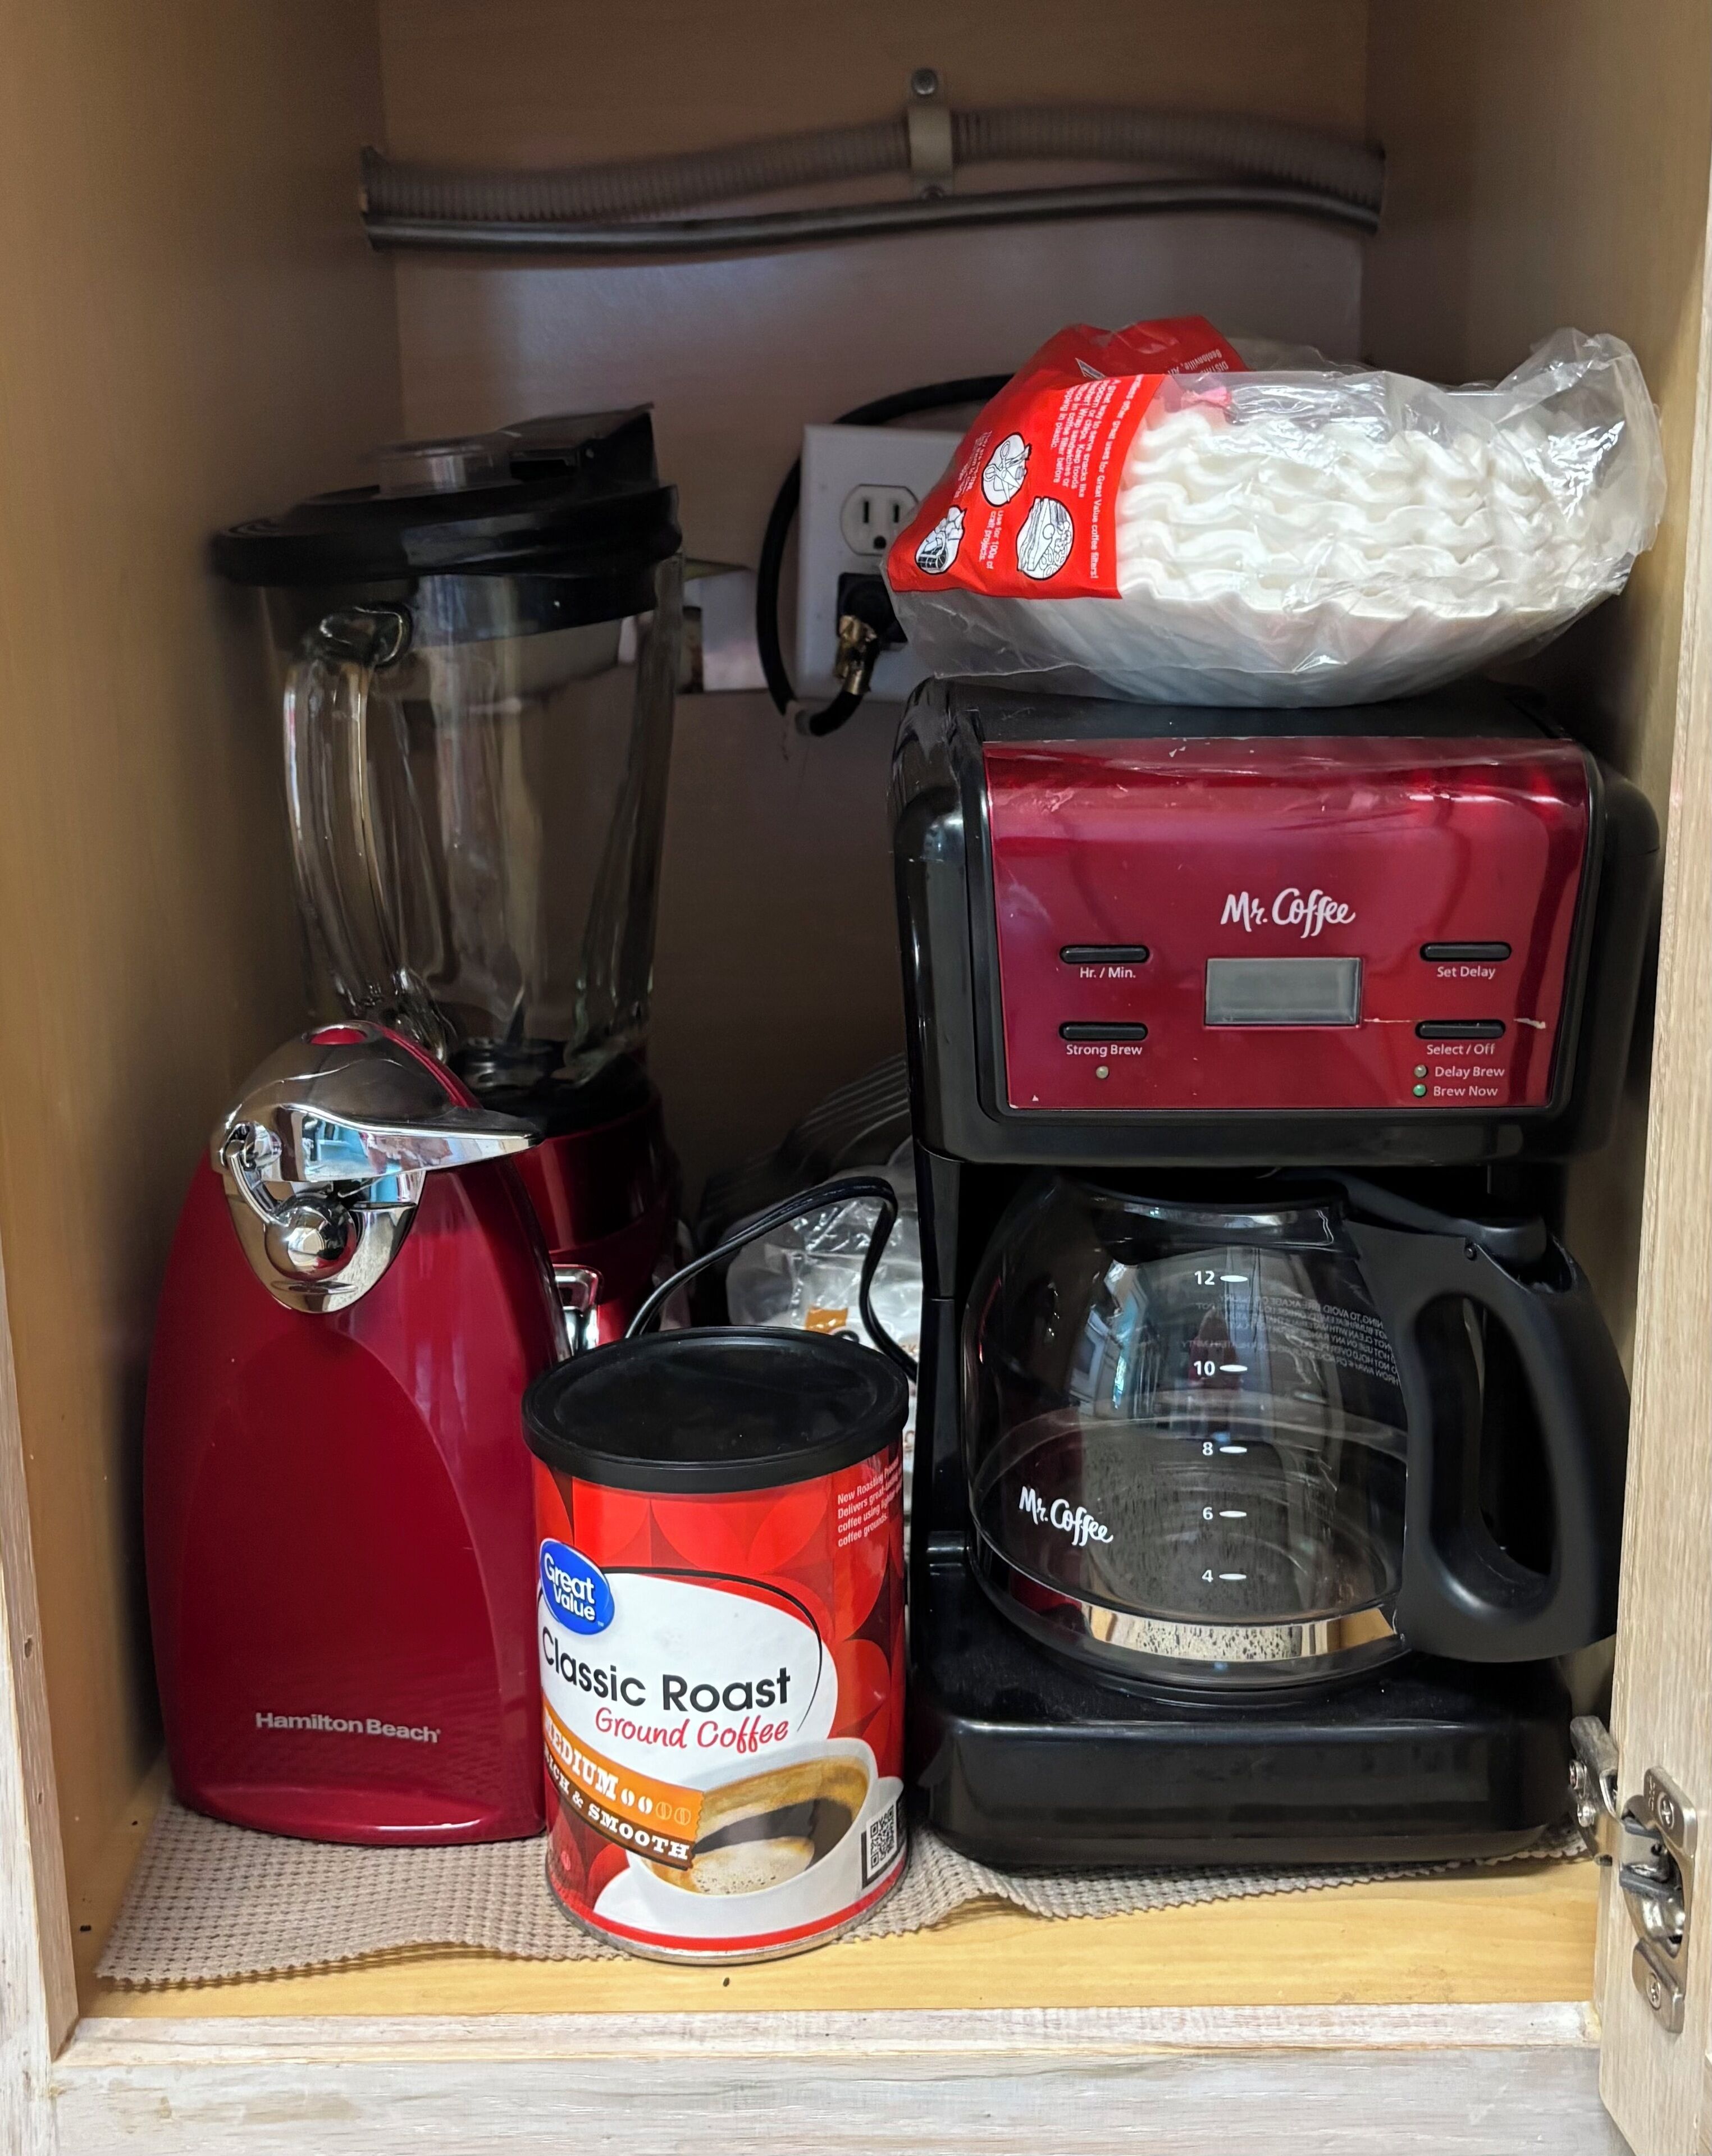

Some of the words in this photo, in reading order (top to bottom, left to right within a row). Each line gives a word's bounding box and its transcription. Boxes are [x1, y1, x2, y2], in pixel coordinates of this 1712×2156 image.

[1103, 385, 1116, 404] great
[1074, 408, 1089, 428] Wrap
[1095, 405, 1108, 419] way
[1117, 400, 1131, 419] other
[1062, 412, 1076, 436] coffee
[1092, 420, 1102, 429] to
[1107, 420, 1121, 440] great
[1085, 430, 1098, 451] serve
[1102, 441, 1113, 460] uses
[1064, 430, 1079, 476] sandwiches
[1073, 444, 1086, 464] Keep
[1071, 465, 1081, 489] foods
[1080, 453, 1090, 481] snacks
[1099, 461, 1109, 473] for
[1094, 475, 1106, 497] Great
[987, 510, 997, 529] craft
[996, 510, 1005, 526] Use
[1092, 499, 1102, 523] Value
[993, 527, 1002, 538] for
[1090, 524, 1100, 550] coffee
[987, 540, 999, 559] 100s
[986, 561, 994, 570] of
[1090, 552, 1099, 578] filters!
[1221, 891, 1268, 932] Mr.
[1271, 887, 1356, 939] Coffee
[1080, 967, 1097, 978] Hr.
[1099, 967, 1105, 978] /
[1108, 966, 1136, 978] Min.
[1437, 966, 1457, 977] Set
[1460, 966, 1496, 980] Delay
[1066, 1044, 1108, 1057] Strong
[1111, 1044, 1143, 1055] Brew
[1427, 1044, 1463, 1055] Select
[1466, 1044, 1472, 1055] /
[1473, 1044, 1495, 1055] Off
[1435, 1066, 1471, 1080] Delay
[1473, 1066, 1505, 1077] Brew
[1433, 1086, 1465, 1097] Brew
[1468, 1086, 1498, 1097] Now
[1194, 1270, 1215, 1285] 12
[1193, 1360, 1215, 1376] 10
[1202, 1441, 1213, 1456] 8
[857, 1472, 884, 1497] Roasting
[838, 1498, 868, 1519] Delivers
[838, 1515, 862, 1533] coffee
[863, 1504, 880, 1522] using
[1019, 1485, 1049, 1525] Mr.
[1050, 1498, 1114, 1547] Coffee
[1202, 1506, 1213, 1520] 6
[838, 1529, 862, 1547] coffee
[544, 1552, 595, 1604] Great
[1201, 1569, 1213, 1583] 4
[553, 1583, 596, 1621] Value
[542, 1626, 646, 1707] Classic
[662, 1666, 791, 1713] Roast
[255, 1712, 364, 1734] Hamilton
[366, 1719, 439, 1743] Beach
[595, 1707, 691, 1749] Ground
[696, 1714, 789, 1753] Coffee
[543, 1706, 619, 1801] MEDIUM
[572, 1790, 584, 1809] &
[588, 1803, 690, 1860] SMOOTH
